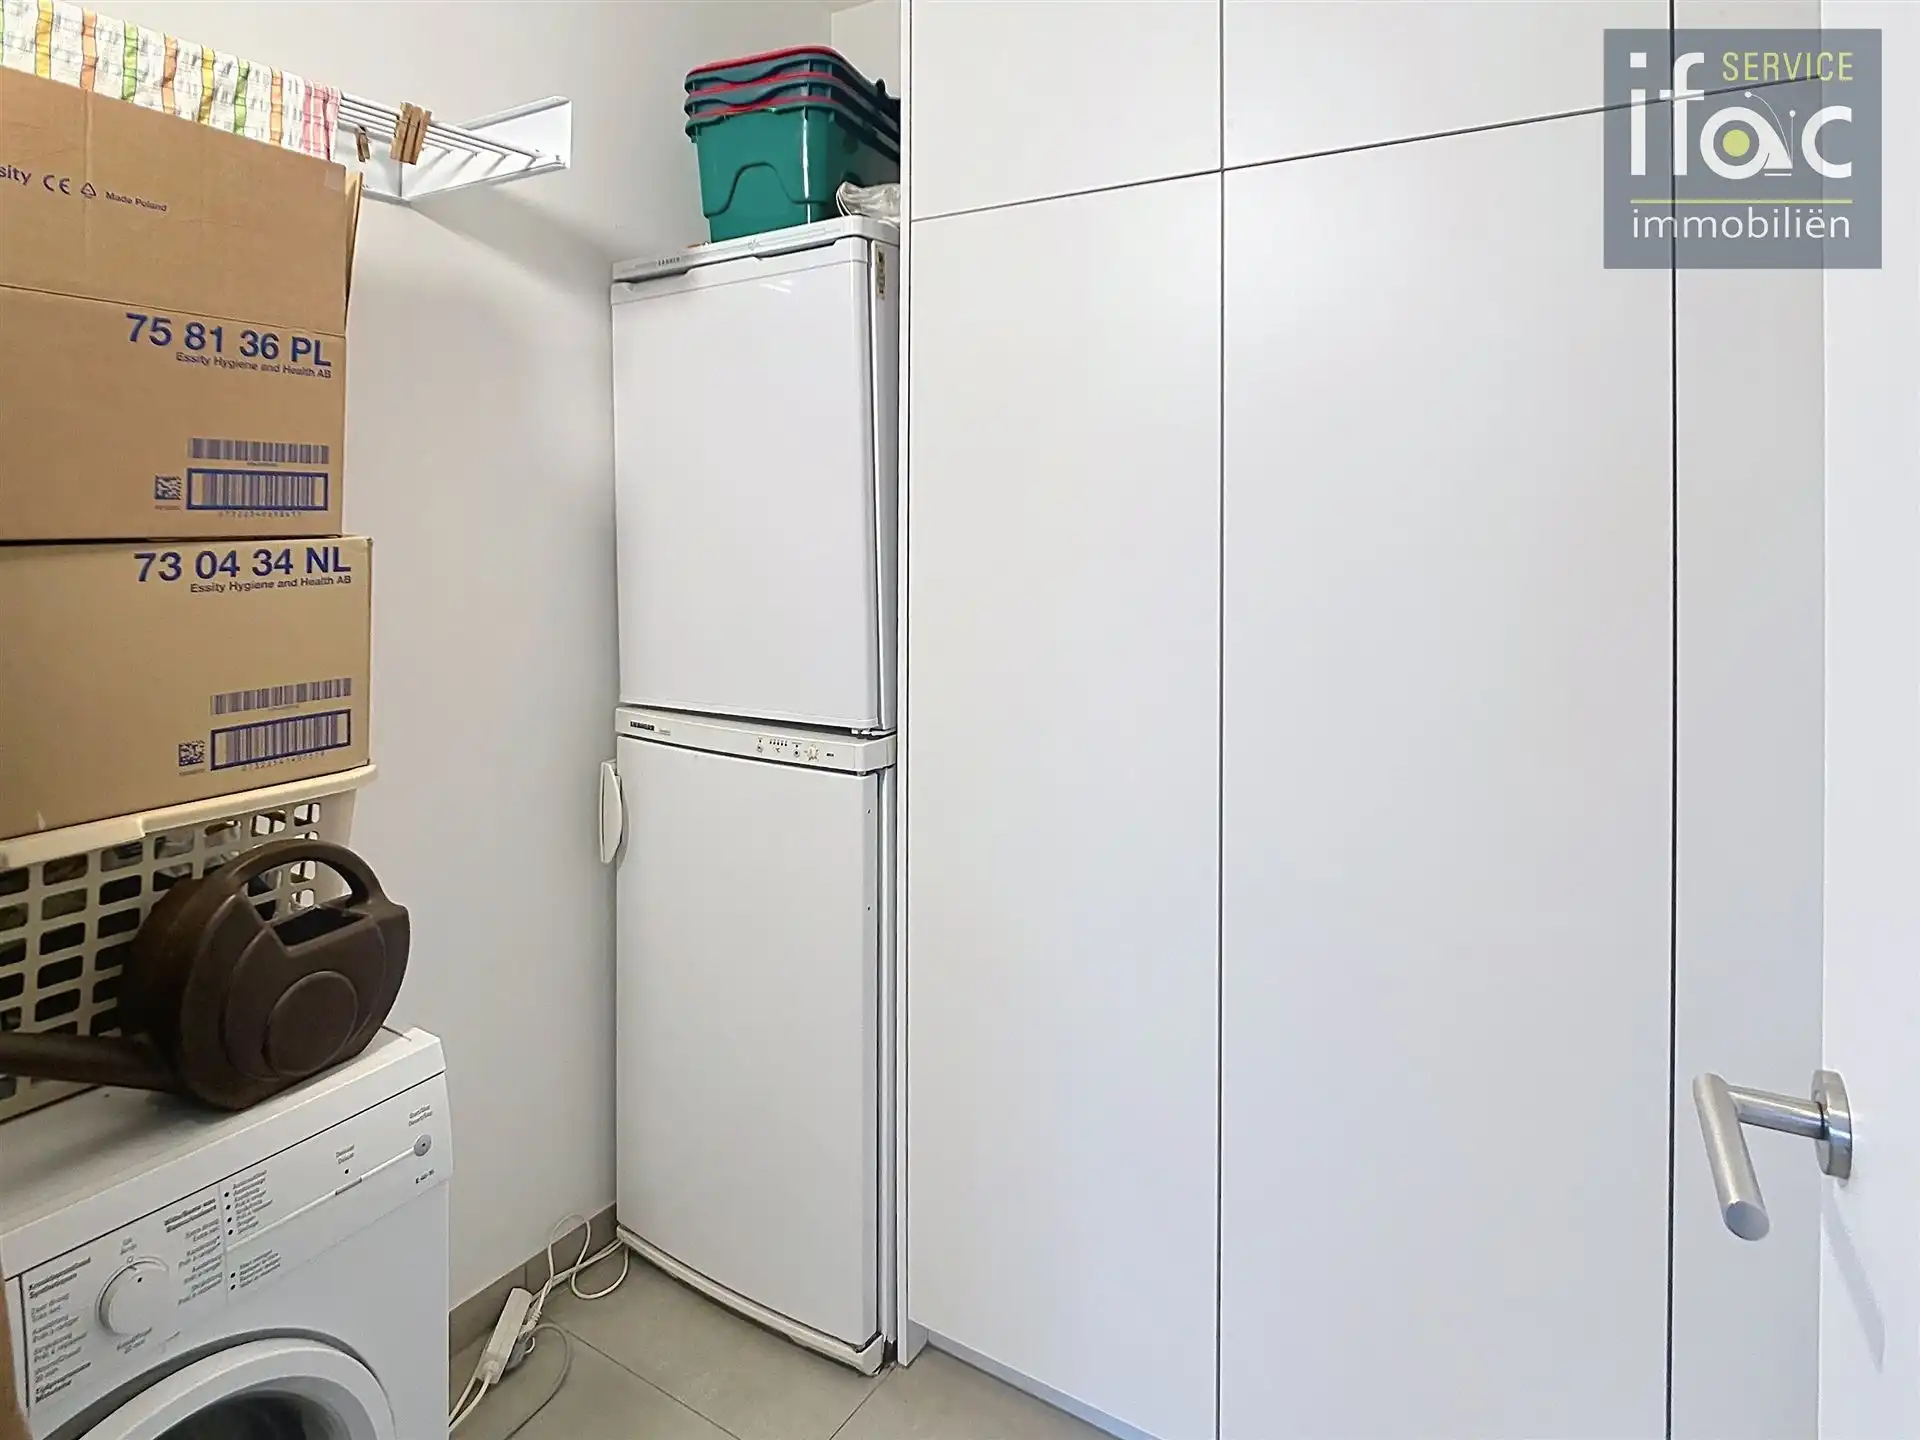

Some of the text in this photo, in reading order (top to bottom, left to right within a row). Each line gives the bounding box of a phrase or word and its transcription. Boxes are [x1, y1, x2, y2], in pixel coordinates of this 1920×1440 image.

[105, 191, 133, 205] Made
[135, 197, 168, 212] Poland
[126, 311, 332, 367] 75 81 36 PL
[175, 351, 332, 379] Essity Hygiene and Health AB
[133, 546, 351, 582] 73 04 34 NL
[190, 575, 352, 594] Essity Hygiene and Health AB
